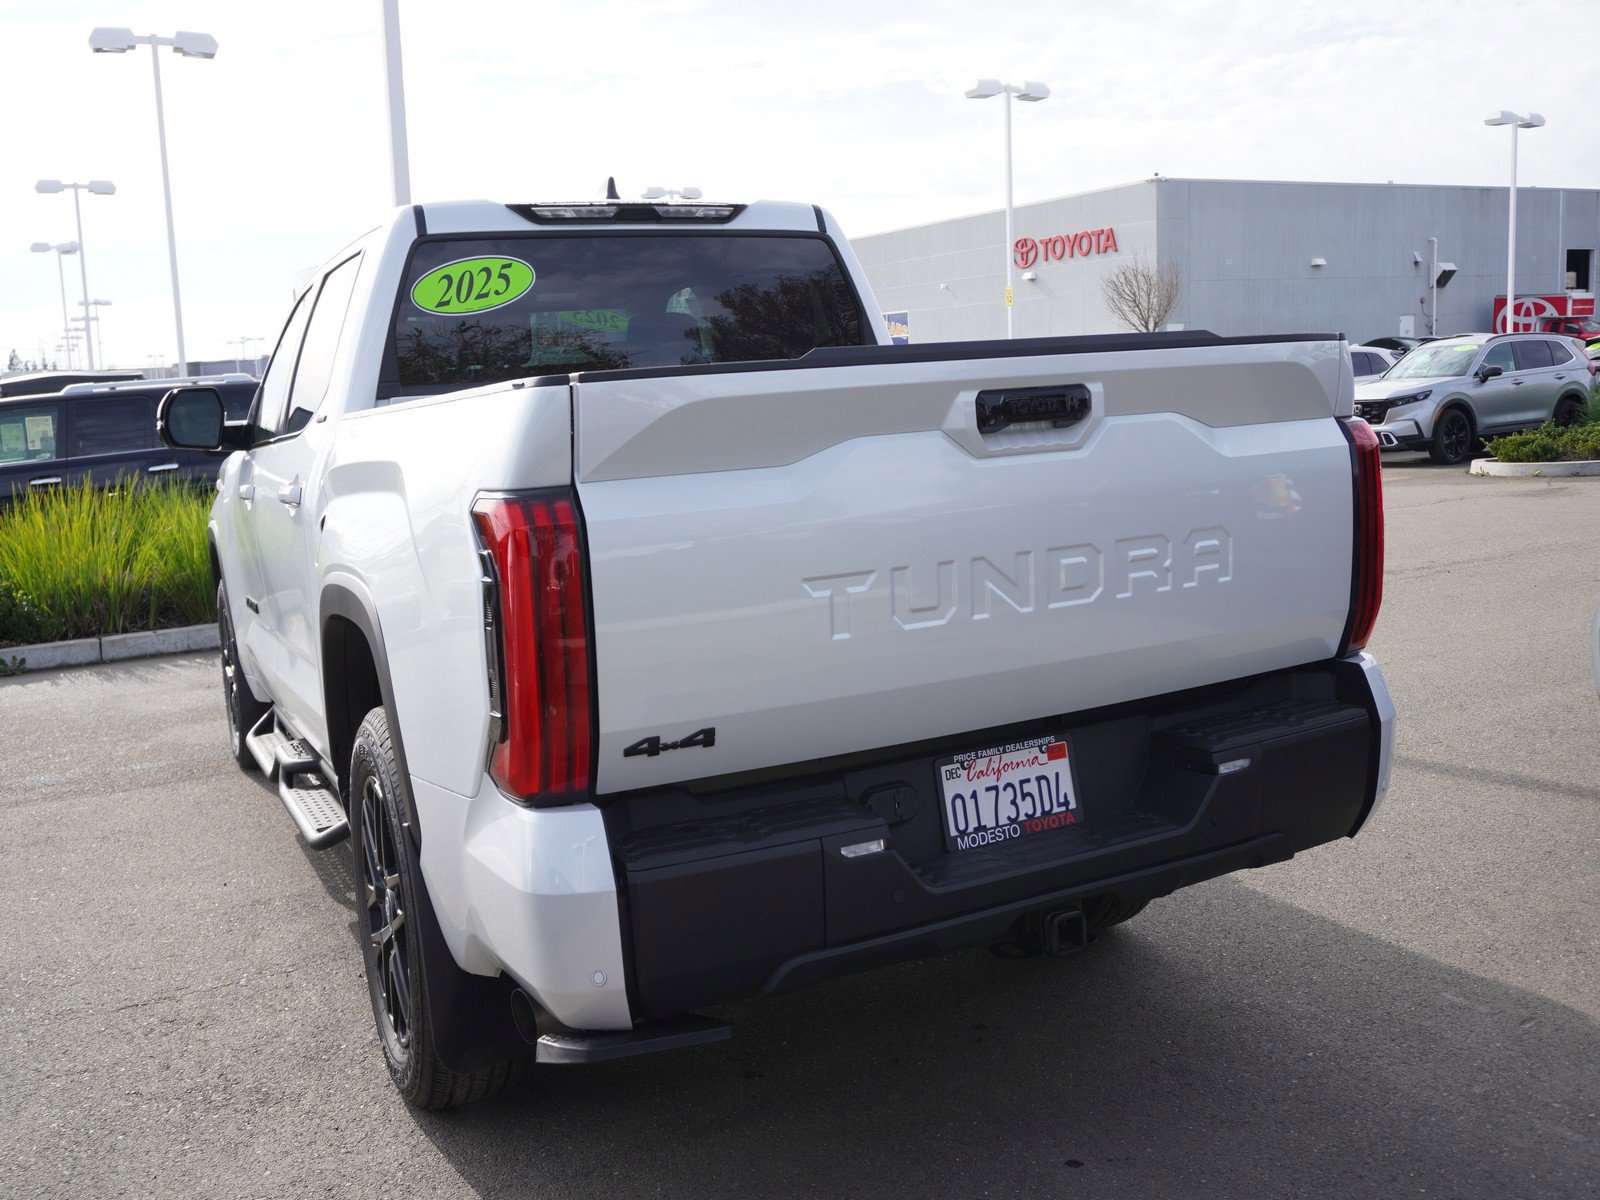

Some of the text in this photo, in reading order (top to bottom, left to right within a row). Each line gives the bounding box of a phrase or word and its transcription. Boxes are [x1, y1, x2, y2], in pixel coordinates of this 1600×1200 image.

[1039, 227, 1118, 262] TOYOTA
[434, 262, 513, 308] 2025
[802, 524, 1233, 641] TUNDRA
[953, 750, 977, 763] PRICE
[978, 747, 1004, 759] FAMILY
[1005, 735, 1056, 753] DEALERSHIPS
[966, 751, 1049, 783] California
[945, 767, 962, 781] DEC
[950, 771, 1071, 835] 01735D4
[957, 812, 1076, 850] MODESTO TOYOTA
